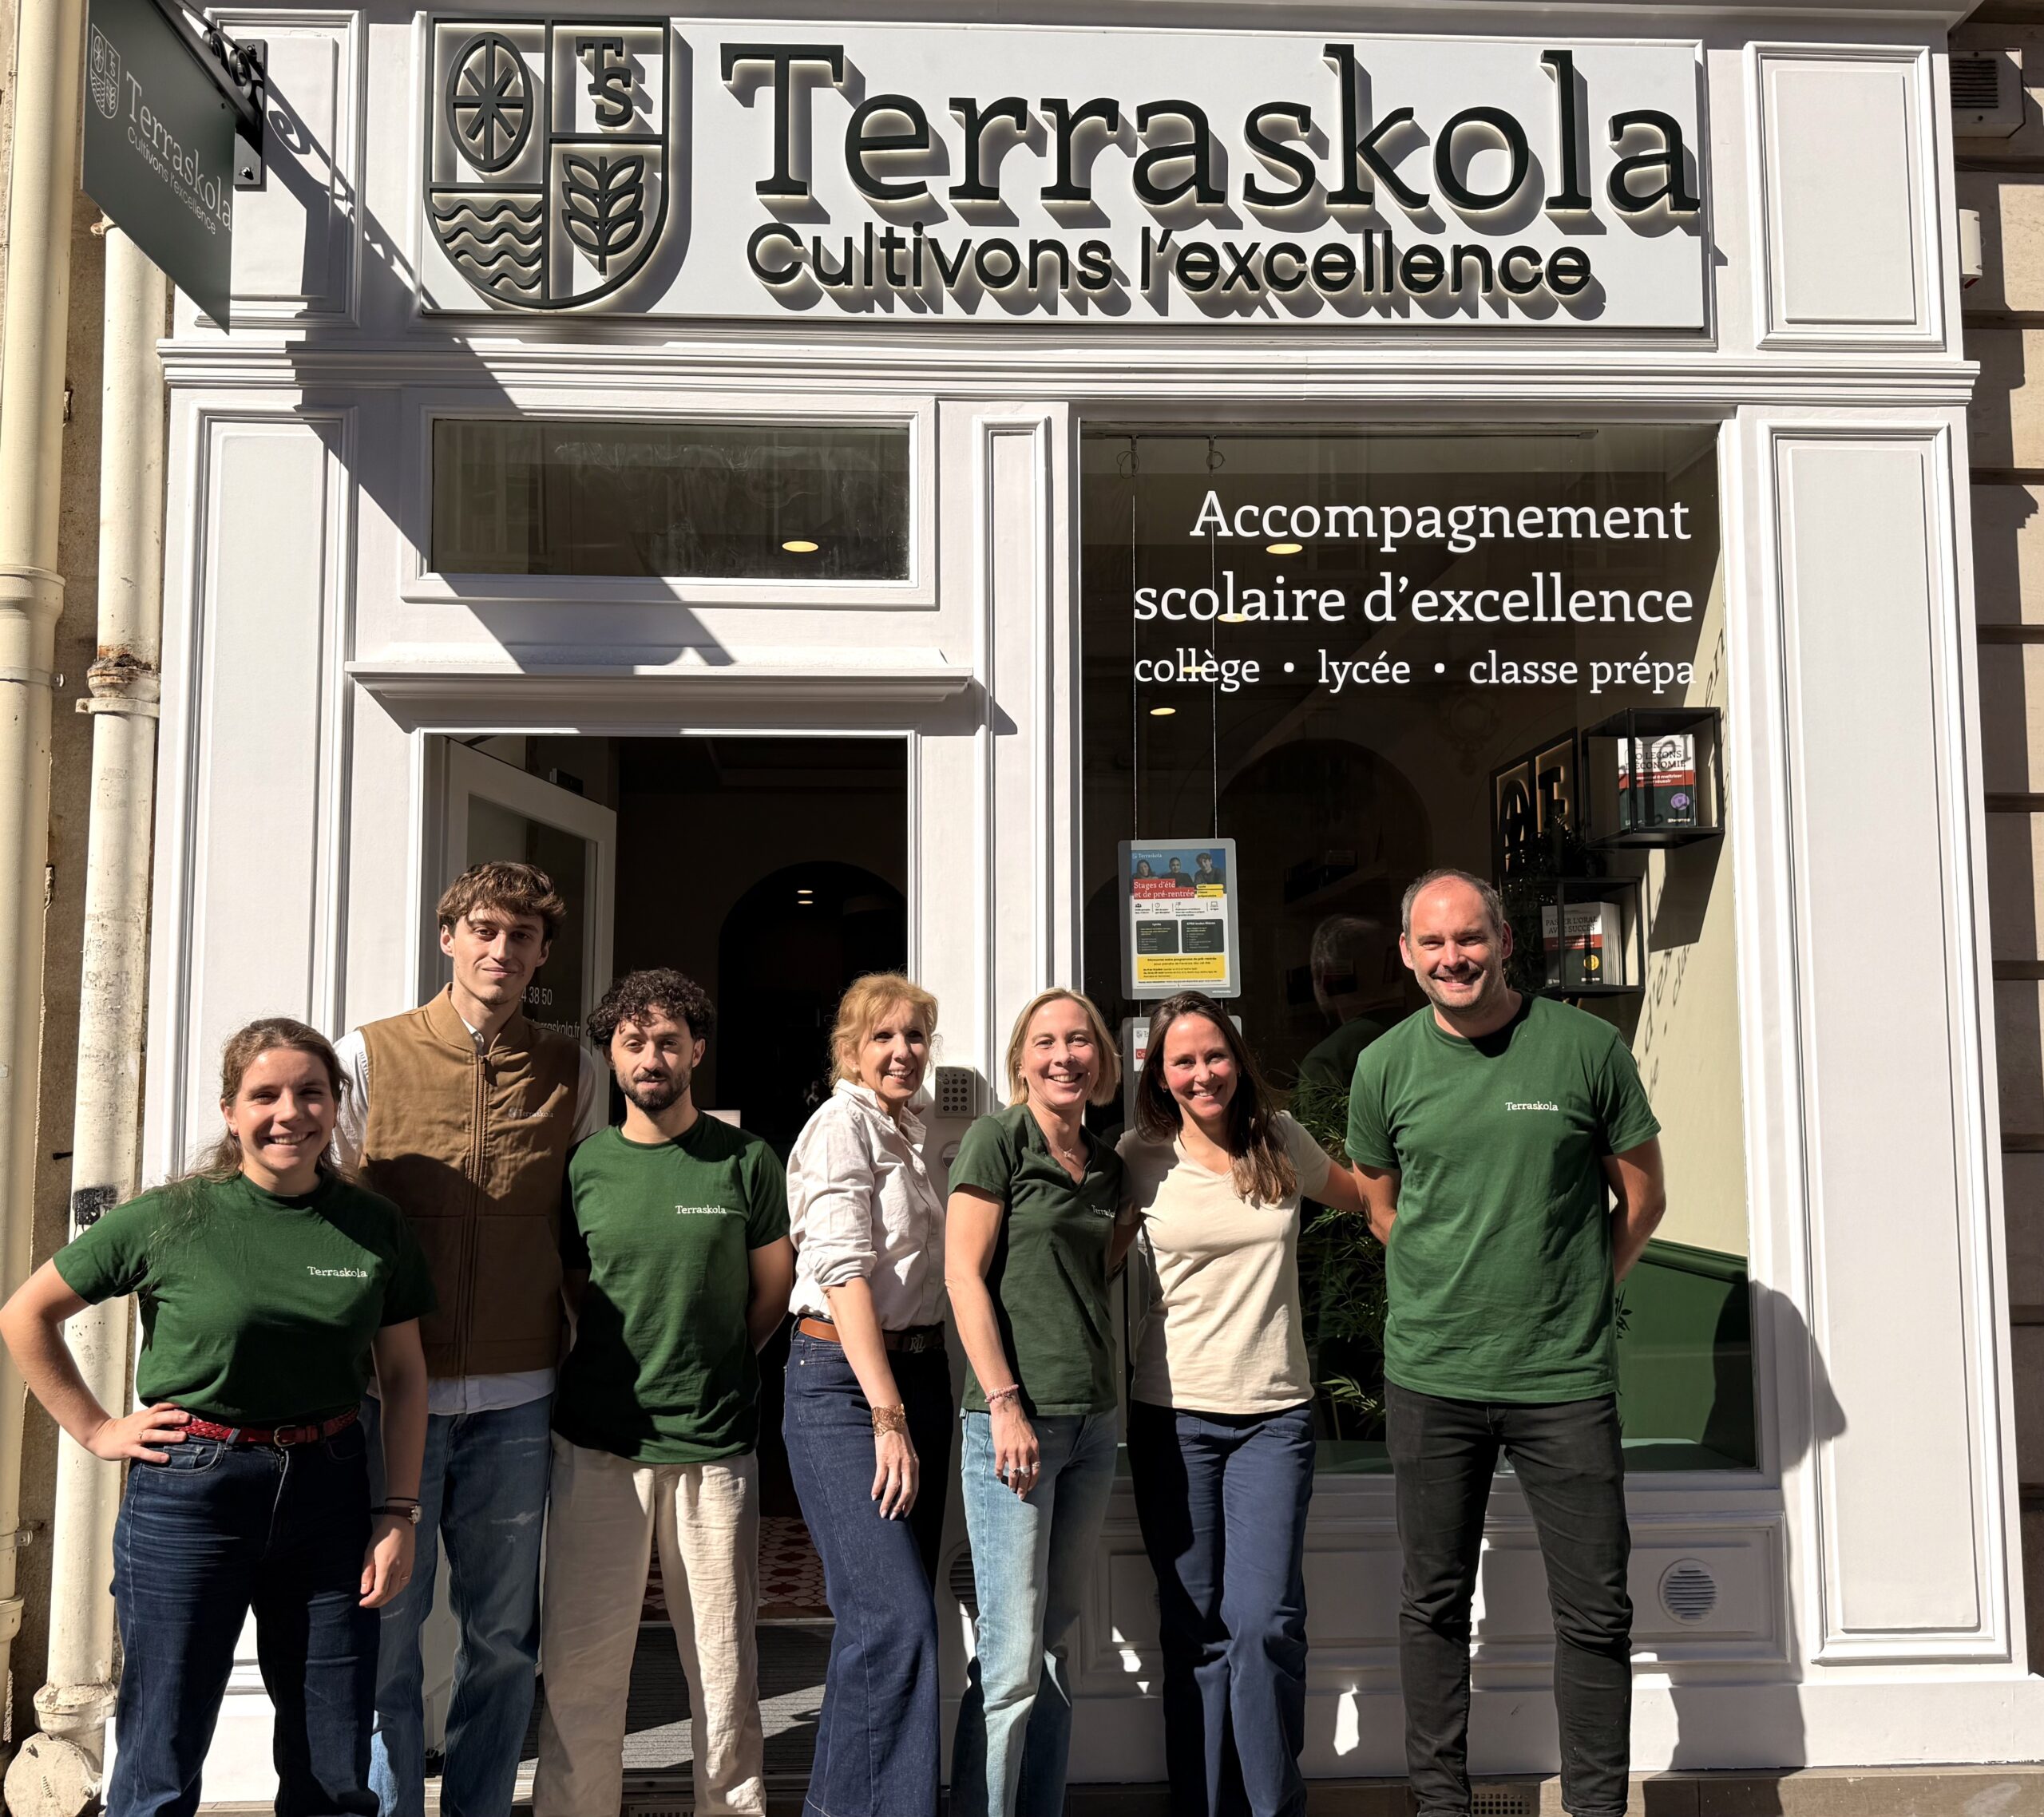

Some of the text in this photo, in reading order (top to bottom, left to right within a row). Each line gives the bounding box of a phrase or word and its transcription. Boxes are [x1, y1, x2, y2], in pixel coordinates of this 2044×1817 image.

[720, 43, 1700, 212] Terraskola
[126, 70, 232, 232] Terraskola
[128, 126, 168, 182] Cultivons
[747, 221, 1590, 295] Cultivons l'excellence
[1190, 489, 1692, 553] Accompagnement
[1135, 571, 1693, 623] scolaire d'excellence
[1135, 648, 1697, 694] collège lycée classe prépa
[1134, 881, 1157, 891] Stages
[1153, 889, 1195, 899] pré-rentrée
[529, 986, 540, 1004] 38
[542, 988, 553, 1006] 50
[518, 1108, 554, 1118] Terraskola
[1505, 1100, 1559, 1111] Terraskola
[674, 1204, 727, 1214] Terraskola
[307, 1265, 369, 1278] Terraskola
